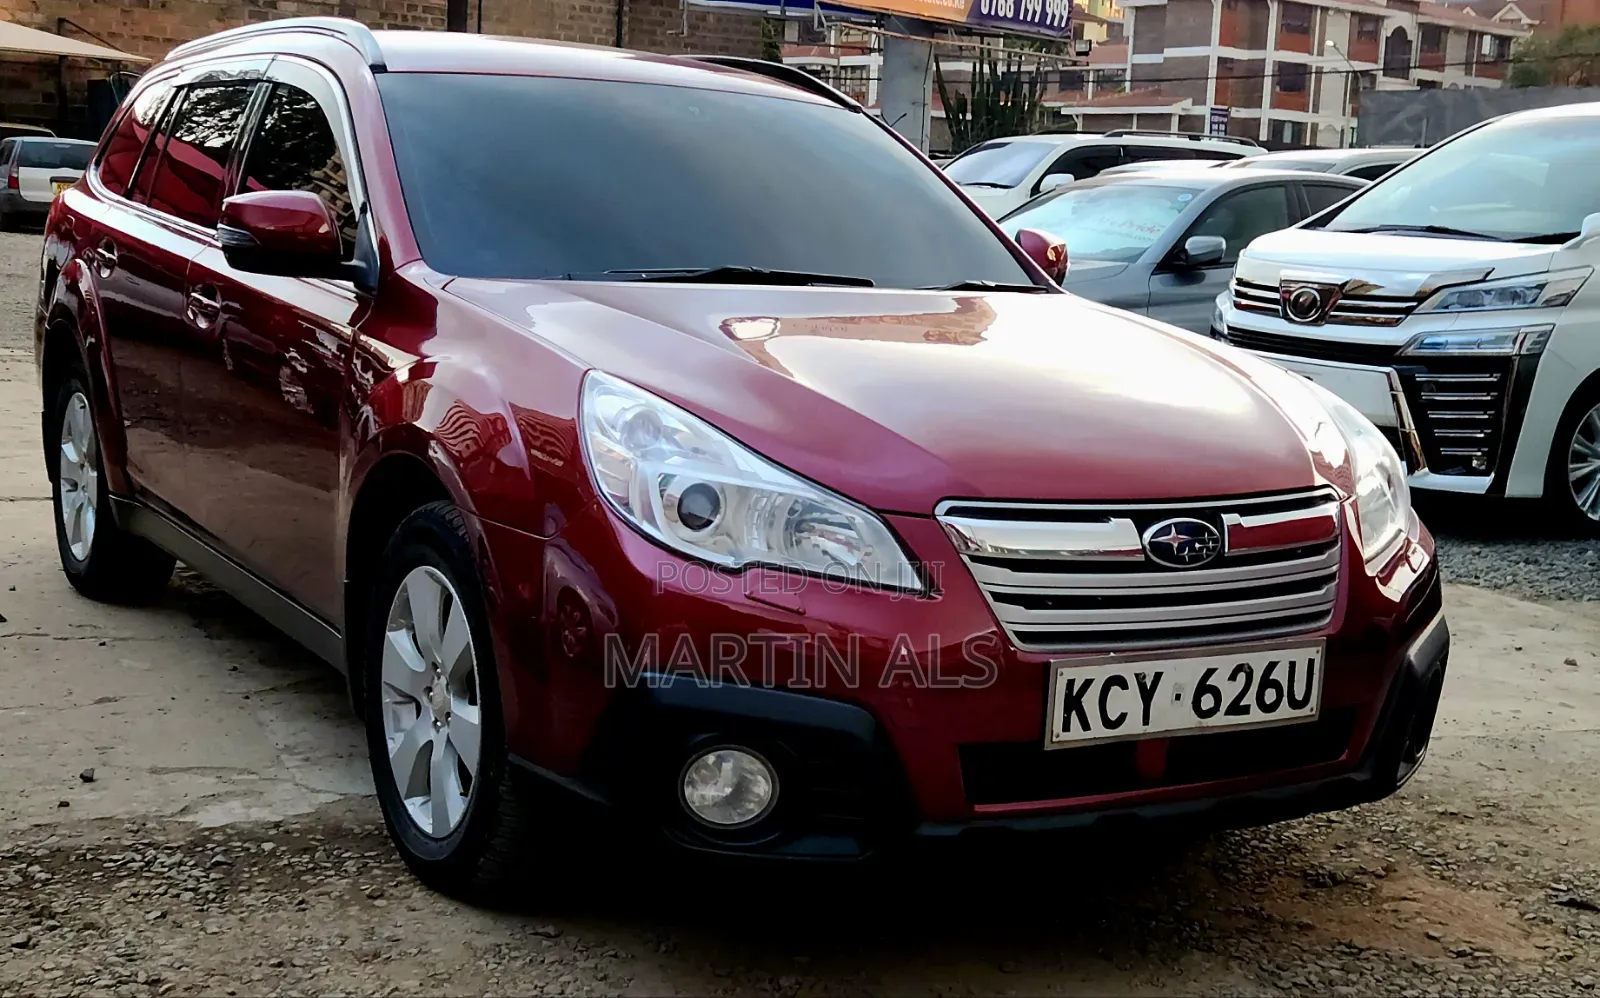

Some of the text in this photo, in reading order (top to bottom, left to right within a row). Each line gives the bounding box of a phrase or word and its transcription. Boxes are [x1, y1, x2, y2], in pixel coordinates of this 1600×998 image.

[1046, 0, 1069, 28] 999
[1061, 657, 1316, 733] KCY 626U
